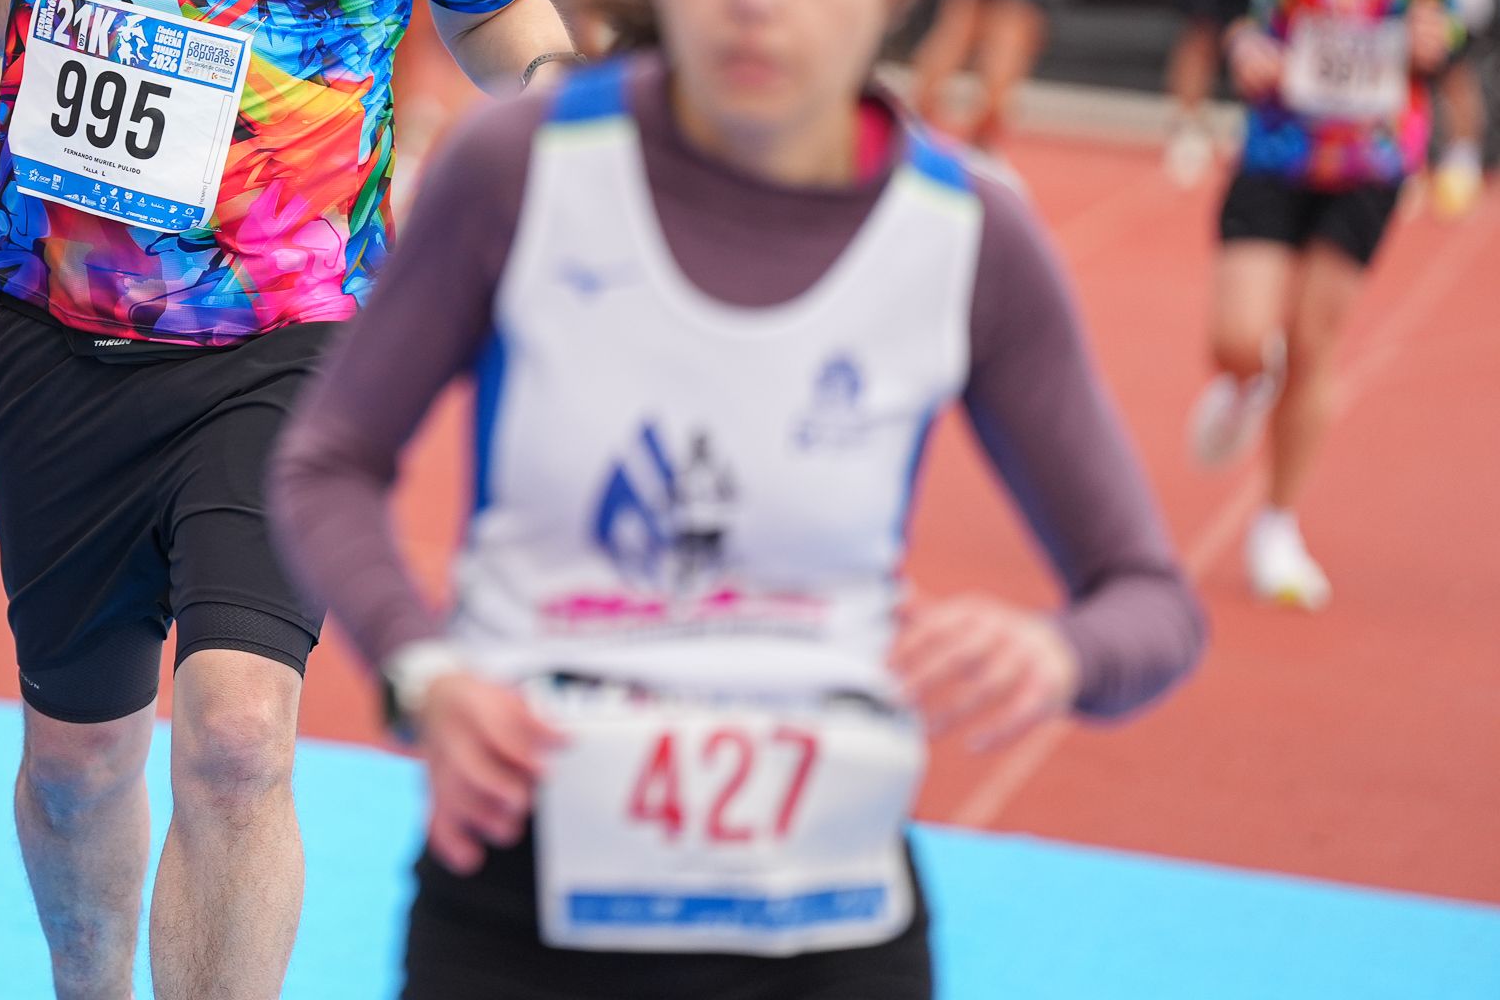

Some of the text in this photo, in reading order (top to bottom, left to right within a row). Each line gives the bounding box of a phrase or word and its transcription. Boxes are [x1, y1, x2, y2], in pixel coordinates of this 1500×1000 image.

[36, 8, 48, 38] MEDIA
[155, 34, 182, 48] LUCENA
[188, 40, 229, 57] carreras
[149, 53, 178, 73] 2026
[186, 48, 235, 67] populares
[51, 59, 172, 159] 995
[63, 148, 141, 174] FERNANDO MURIEL PULIDO
[83, 166, 98, 174] TALLA
[628, 727, 820, 844] 427
